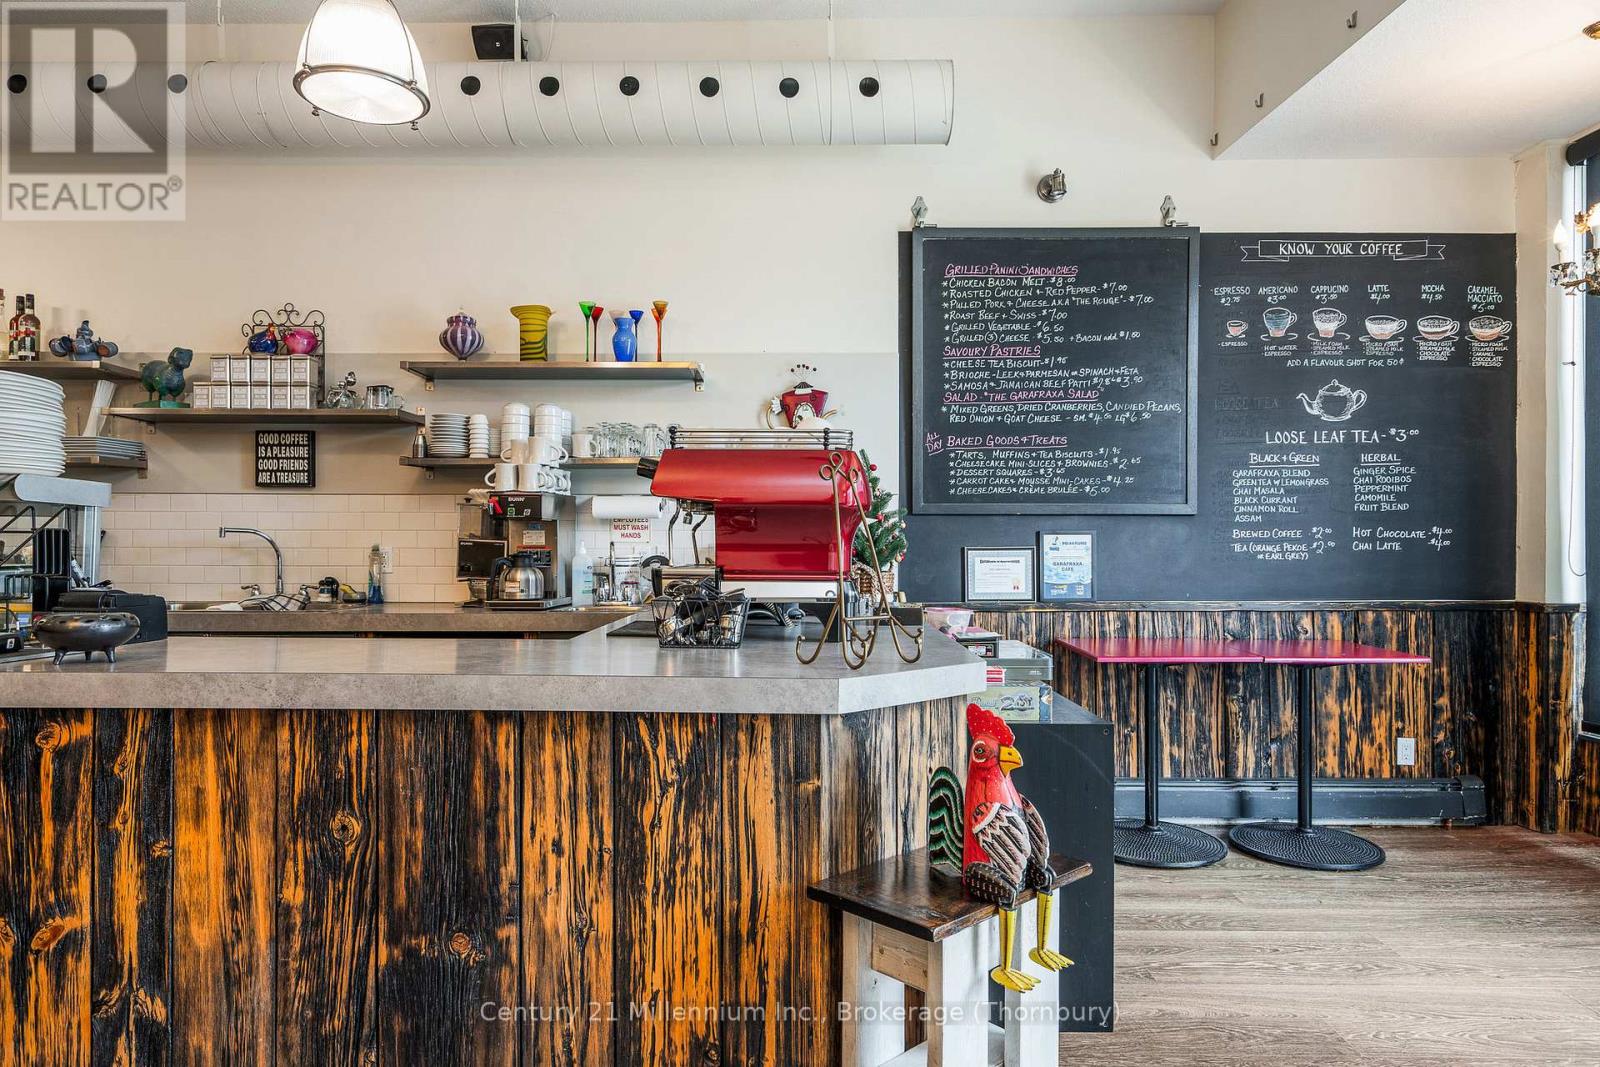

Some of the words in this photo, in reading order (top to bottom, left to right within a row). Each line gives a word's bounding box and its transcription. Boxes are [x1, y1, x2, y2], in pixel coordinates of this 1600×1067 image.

[1279, 243, 1315, 255] KNOW
[1325, 243, 1354, 255] YOUR
[1360, 243, 1404, 255] COFFEE
[945, 264, 988, 276] GRILLED
[989, 263, 1017, 275] PANINI
[1018, 264, 1078, 275] SANDWICHES
[949, 277, 985, 288] CHICKEN
[986, 278, 1017, 287] BACON
[1022, 277, 1046, 286] MELT
[1421, 284, 1445, 292] MOCHA
[950, 289, 991, 298] ROASTED
[995, 287, 1032, 297] CHICKEN
[1045, 287, 1064, 297] RED
[1066, 285, 1097, 295] PEPPER
[1214, 287, 1250, 295] ESPRESSO
[1258, 286, 1298, 295] AMERICANO
[1310, 285, 1349, 294] CAPPUCINO
[1468, 286, 1498, 294] CARAMEL
[950, 300, 981, 309] PULLED
[985, 300, 1005, 308] PORK
[1015, 298, 1049, 307] CHEESE
[1468, 295, 1502, 303] MACCIATO
[950, 310, 975, 320] ROAST
[978, 310, 1000, 320] BEEF
[951, 322, 985, 332] GRILLED
[988, 321, 1030, 331] VEGETABLE
[951, 332, 984, 344] GRILLED
[999, 334, 1030, 343] CHEESE
[1075, 334, 1101, 342] BACON
[943, 346, 987, 356] SAVOURY
[990, 344, 1041, 356] PASTRIES
[950, 359, 986, 368] CHEESE
[988, 360, 1005, 368] TEA
[950, 370, 991, 379] BRIOCHE
[1078, 368, 1114, 376] SPINACH
[1120, 366, 1138, 375] FETA
[950, 382, 988, 391] SAMOSA
[995, 380, 1041, 389] JAMAICAN
[943, 392, 977, 402] SALAD
[1009, 391, 1064, 401] GARAFRAXA
[950, 405, 978, 413] MIXED
[979, 404, 1017, 414] GREENS,
[1017, 403, 1043, 411] DRIED
[1044, 402, 1105, 412] CRANBERRIES,
[1105, 402, 1145, 411] CANDIED
[1147, 401, 1181, 413] PECANS,
[950, 414, 966, 423] RED
[969, 414, 994, 423] ONION
[1003, 414, 1027, 424] GOAT
[1027, 413, 1062, 422] CHEESE
[258, 433, 279, 444] GOOD
[280, 434, 308, 444] COFFEE
[947, 435, 983, 447] BAKED
[986, 435, 1019, 447] GOODS
[1028, 434, 1068, 445] TREATS
[1265, 430, 1308, 444] LOOSE
[1313, 430, 1347, 444] LEAF
[1351, 430, 1380, 443] TEA
[258, 446, 265, 457] IS
[266, 446, 272, 457] A
[273, 446, 308, 457] PLEASURE
[956, 451, 987, 460] TARTS,
[992, 450, 1030, 459] MUFFINS
[1249, 453, 1280, 463] BLACK
[1289, 452, 1320, 464] GREEN
[1361, 454, 1401, 463] HERBAL
[258, 459, 278, 470] GOOD
[279, 459, 308, 470] FRIENDS
[955, 460, 1007, 468] CHEESECAKE
[1065, 460, 1108, 468] BROWNIES
[1232, 469, 1280, 478] GARAFRAXA
[1282, 469, 1310, 477] BLEND
[1353, 467, 1387, 476] GINGER
[1389, 466, 1416, 474] SPICE
[258, 472, 270, 483] ARE
[271, 472, 276, 483] A
[277, 472, 308, 483] TREASURE
[956, 477, 987, 485] CARROT
[989, 477, 1009, 485] CAKE
[1017, 477, 1051, 485] MOUSSE
[1232, 479, 1256, 487] GREEN
[1353, 477, 1372, 485] CHAI
[1375, 475, 1412, 483] ROOIBOS
[1233, 488, 1251, 496] CHAI
[1254, 487, 1285, 495] MASALA
[1354, 485, 1409, 493] PEPPERMINT
[1261, 496, 1298, 504] CURRANT
[1380, 503, 1409, 511] BLEND
[1232, 529, 1270, 539] BREWED
[1272, 528, 1303, 538] COFFEE
[1353, 526, 1372, 538] HOT
[1377, 527, 1426, 538] CHOCOLATE
[1231, 543, 1248, 551] TEA
[1249, 542, 1282, 553] (ORANGE
[1284, 543, 1308, 551] PEKOE
[1352, 541, 1372, 551] CHAI
[1377, 541, 1402, 550] LATTE
[1285, 552, 1309, 560] GREY)
